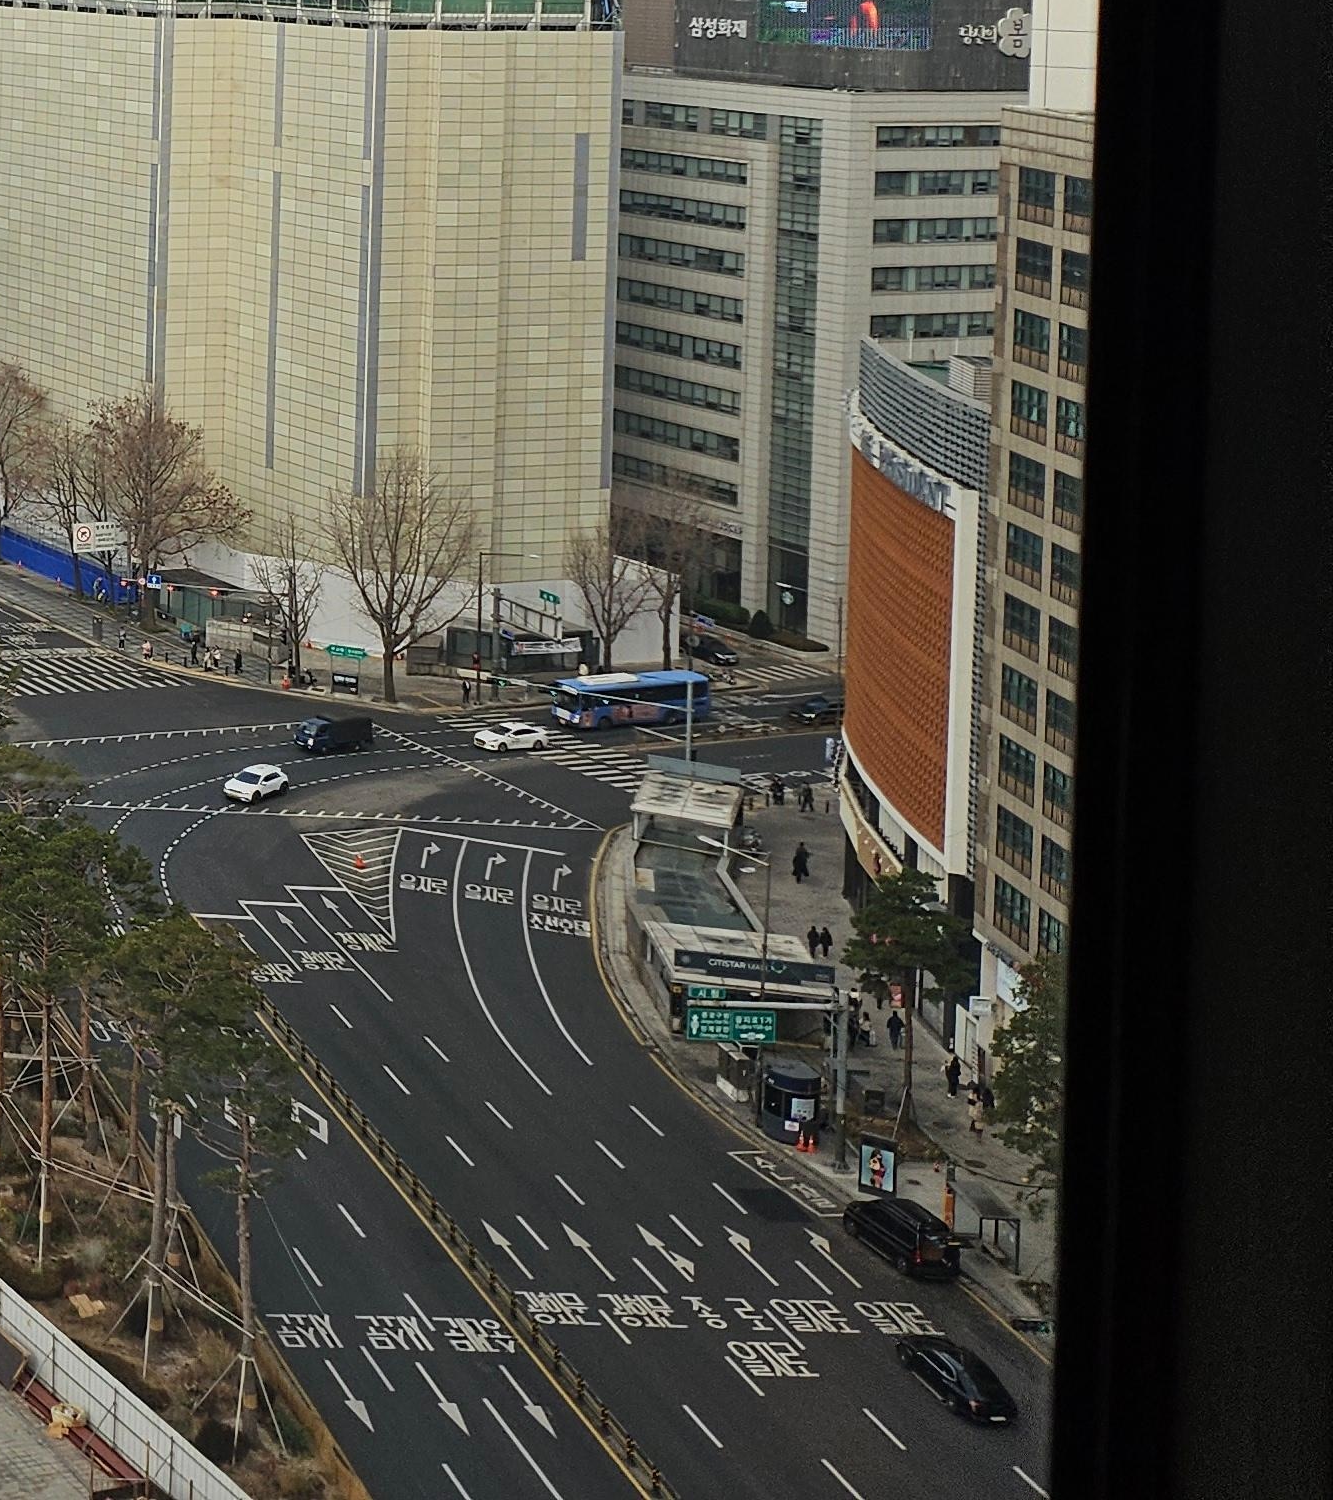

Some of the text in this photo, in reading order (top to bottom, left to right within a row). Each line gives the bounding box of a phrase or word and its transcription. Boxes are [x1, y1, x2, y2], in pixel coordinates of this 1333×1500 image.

[688, 16, 748, 39] 삼성화재
[958, 24, 998, 45] 당신의
[399, 873, 448, 896] 을지로
[464, 883, 515, 906] 을지로
[532, 893, 582, 916] 을지로
[514, 1290, 601, 1327] 광화문
[597, 1293, 689, 1329] 광화문
[769, 1298, 861, 1335] 을지로
[853, 1301, 946, 1337] 을지로
[726, 1340, 821, 1378] 을지로
